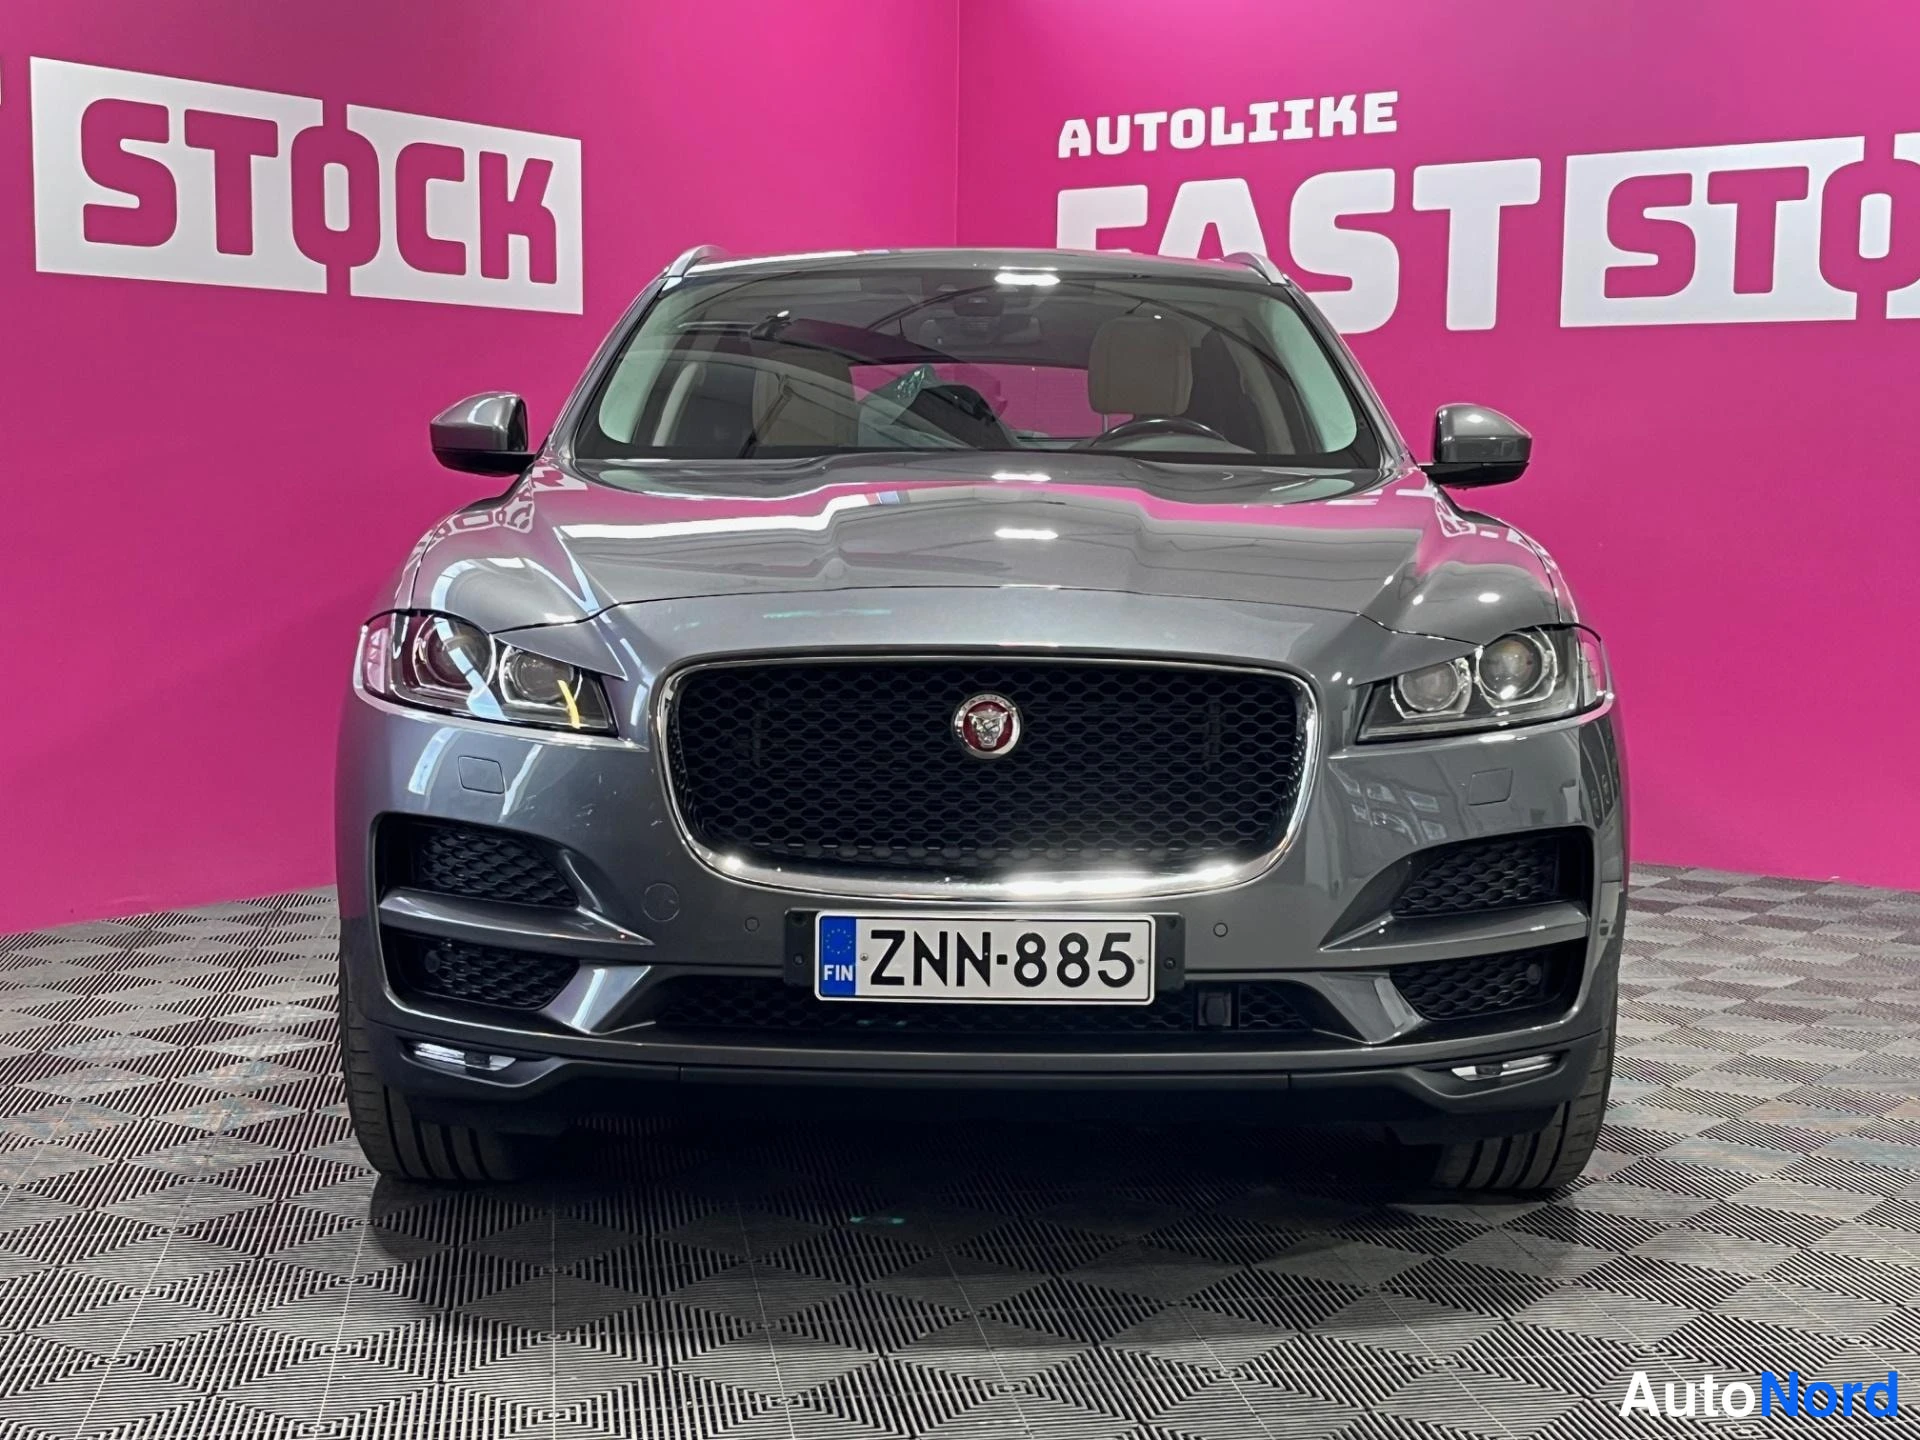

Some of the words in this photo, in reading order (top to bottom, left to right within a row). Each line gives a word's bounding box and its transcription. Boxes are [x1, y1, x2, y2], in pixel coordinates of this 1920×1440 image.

[1058, 90, 1398, 158] AUTOLIIKE
[80, 97, 557, 285] STOCK
[823, 964, 854, 982] FIN
[869, 929, 1136, 988] ZNN-885
